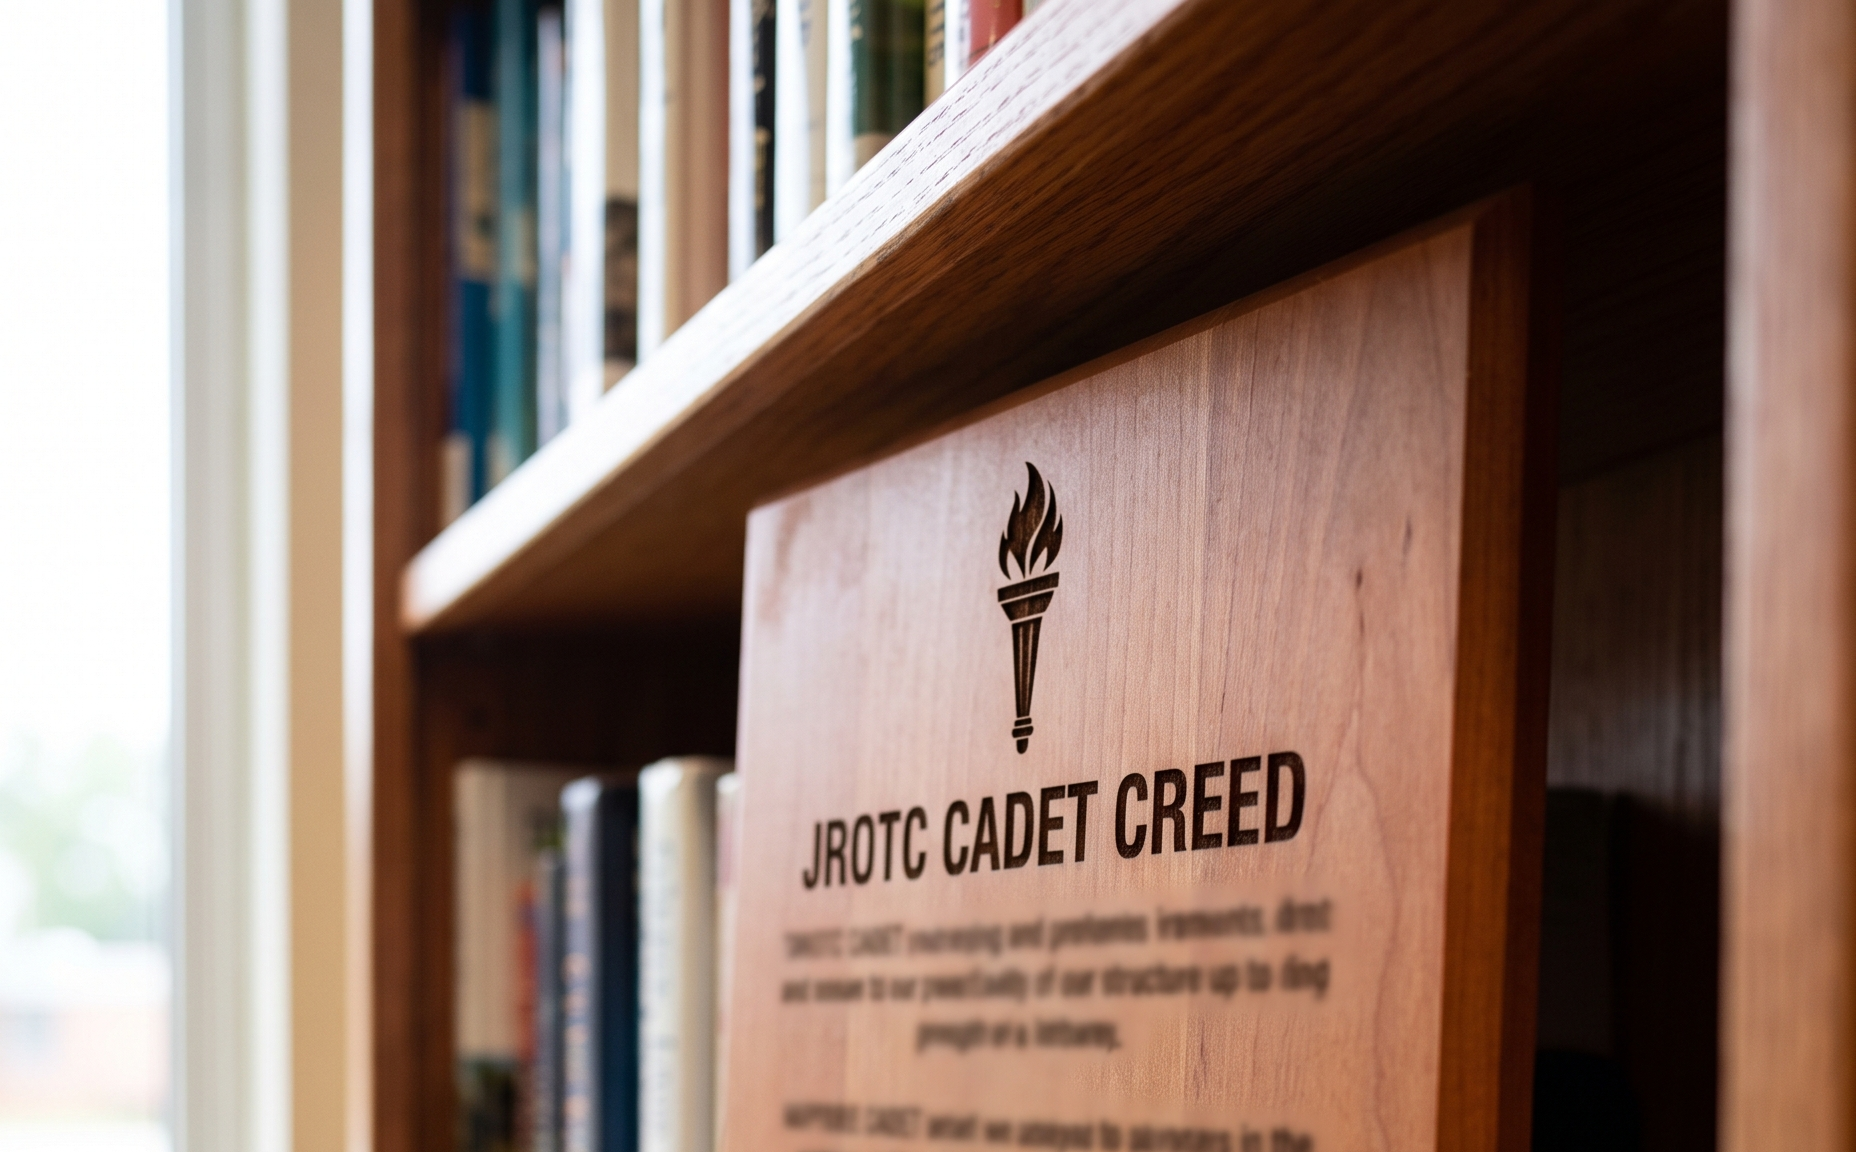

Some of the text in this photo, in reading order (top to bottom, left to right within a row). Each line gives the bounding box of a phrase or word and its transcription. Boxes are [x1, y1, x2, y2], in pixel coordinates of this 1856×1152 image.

[803, 750, 1306, 891] JROTC CADET CREED
